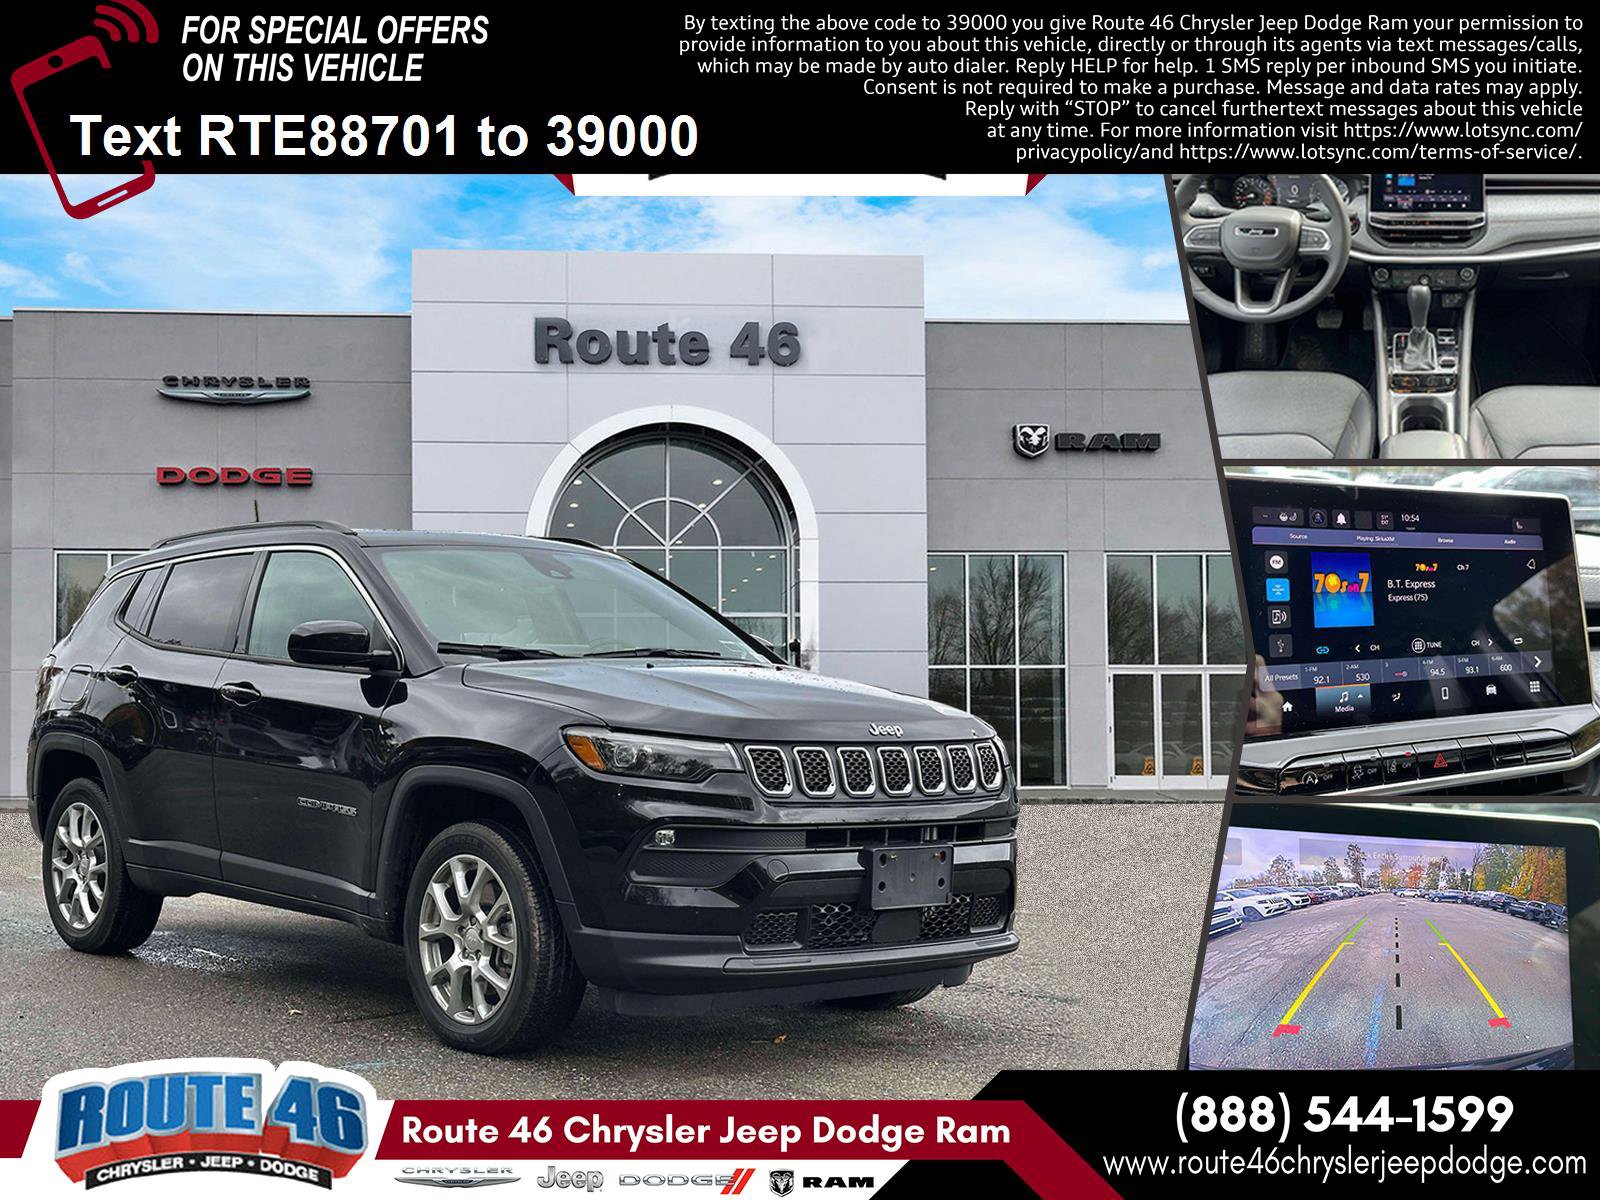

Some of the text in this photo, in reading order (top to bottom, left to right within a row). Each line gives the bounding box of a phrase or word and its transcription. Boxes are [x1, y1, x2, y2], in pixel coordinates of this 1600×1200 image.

[534, 317, 801, 367] Route 46
[162, 375, 311, 388] CHRYSLER
[1054, 432, 1161, 452] RAM
[156, 467, 313, 486] DODGE
[1401, 513, 1420, 522] 10:54
[1387, 580, 1436, 590] B.T. Express
[1387, 593, 1429, 602] Express (75)
[1427, 640, 1442, 648] TUNE
[1430, 668, 1446, 676] 94.5
[1465, 665, 1480, 674] 93.1
[1500, 664, 1513, 672] 600
[1313, 675, 1330, 684] 92.1
[1356, 672, 1370, 681] 530
[868, 723, 904, 738] Jeep
